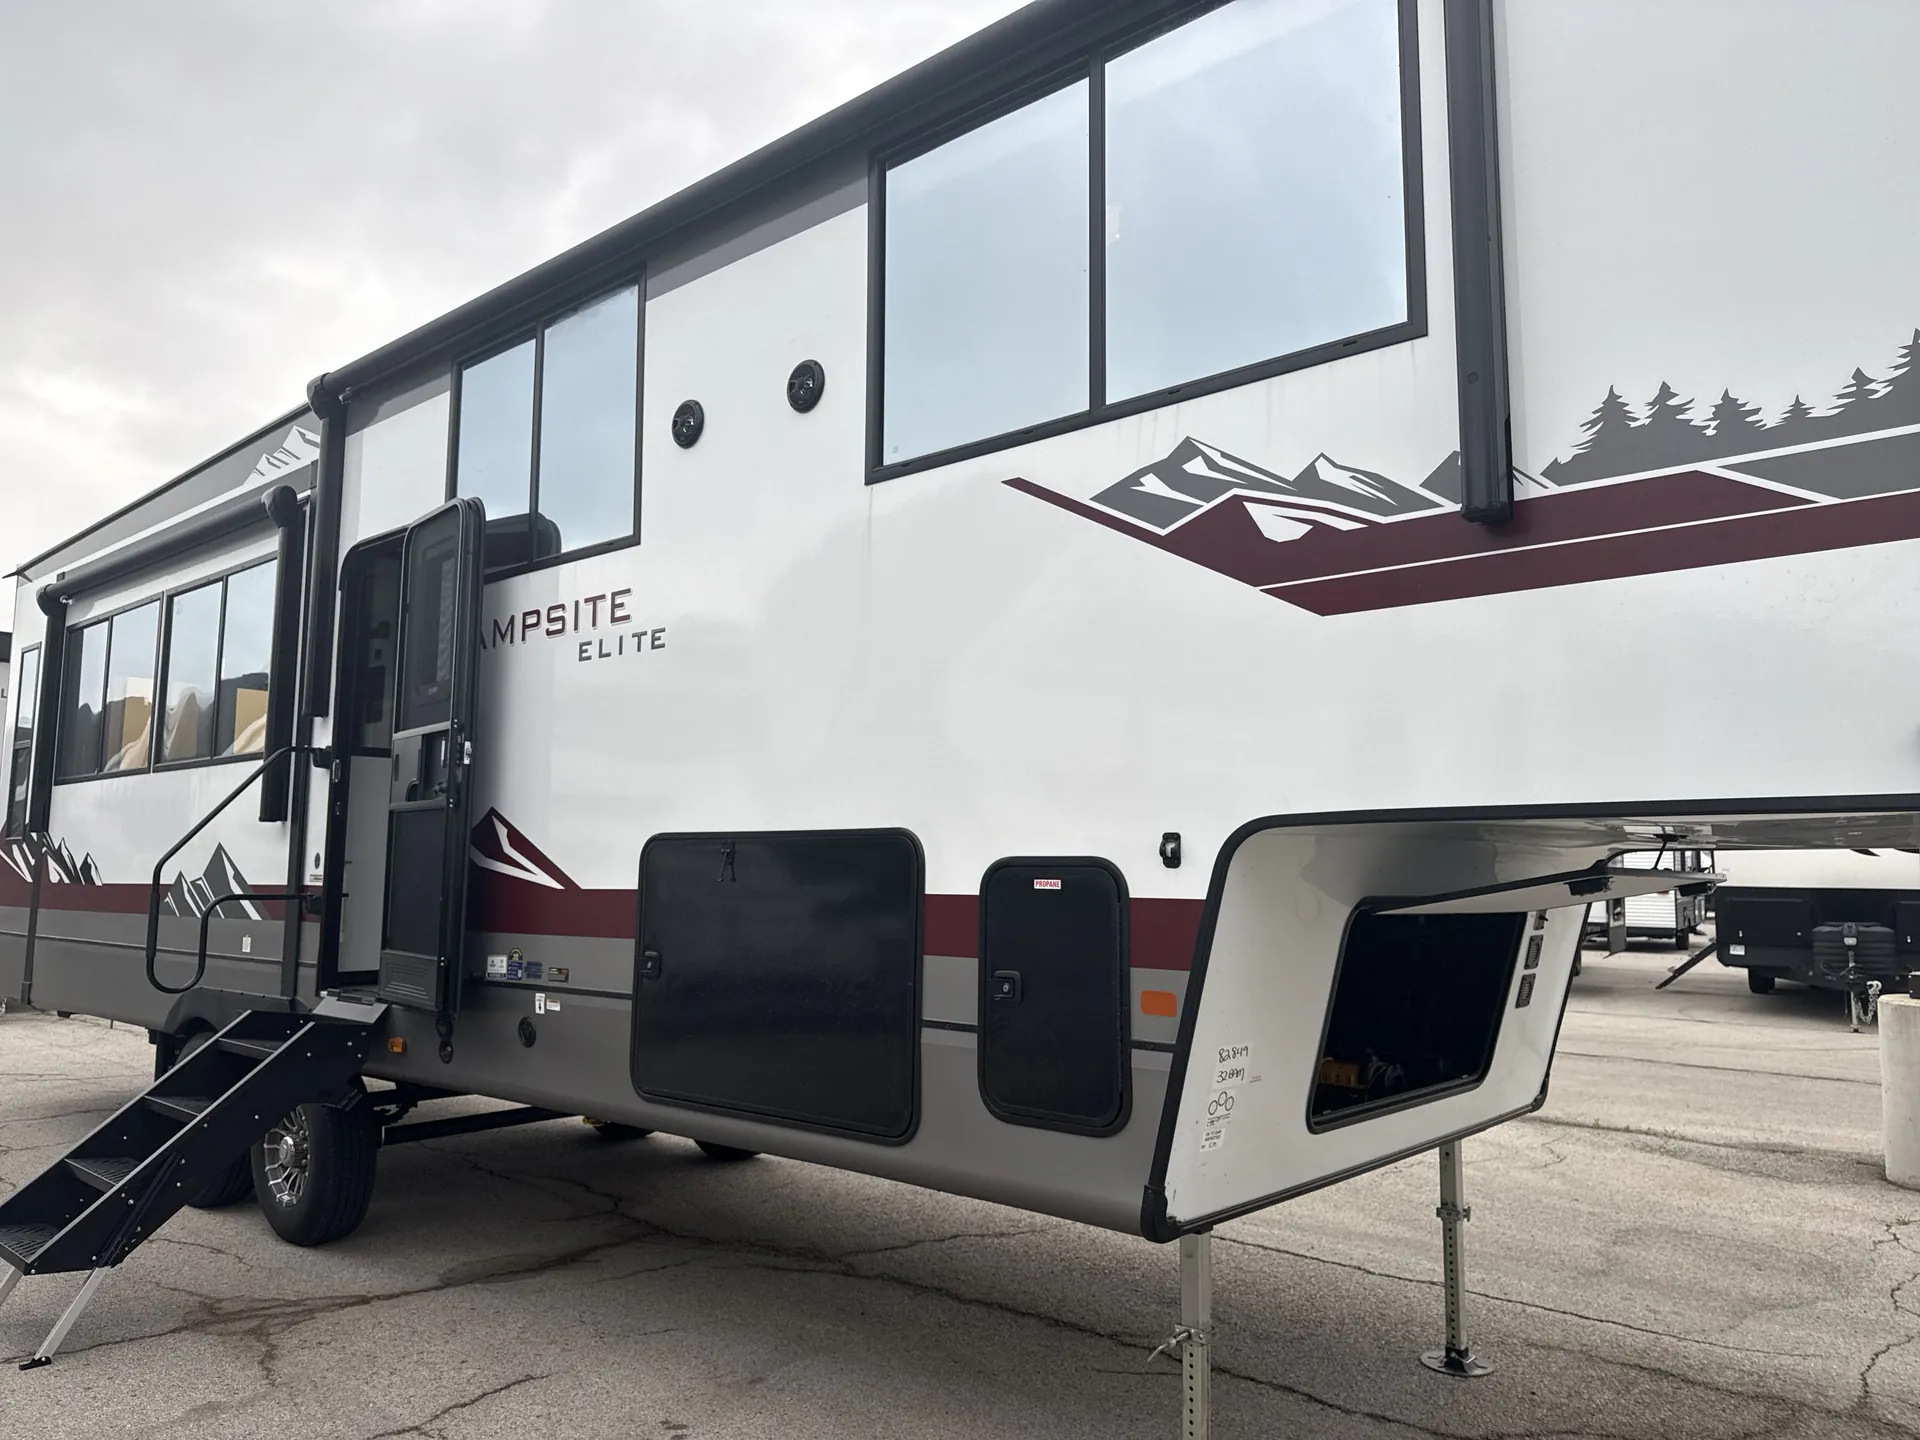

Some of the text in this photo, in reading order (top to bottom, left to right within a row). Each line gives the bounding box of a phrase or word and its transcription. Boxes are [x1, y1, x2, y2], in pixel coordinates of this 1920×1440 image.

[578, 627, 666, 662] ELITE
[1035, 880, 1060, 888] PROPANE
[1218, 1045, 1249, 1064] 82849
